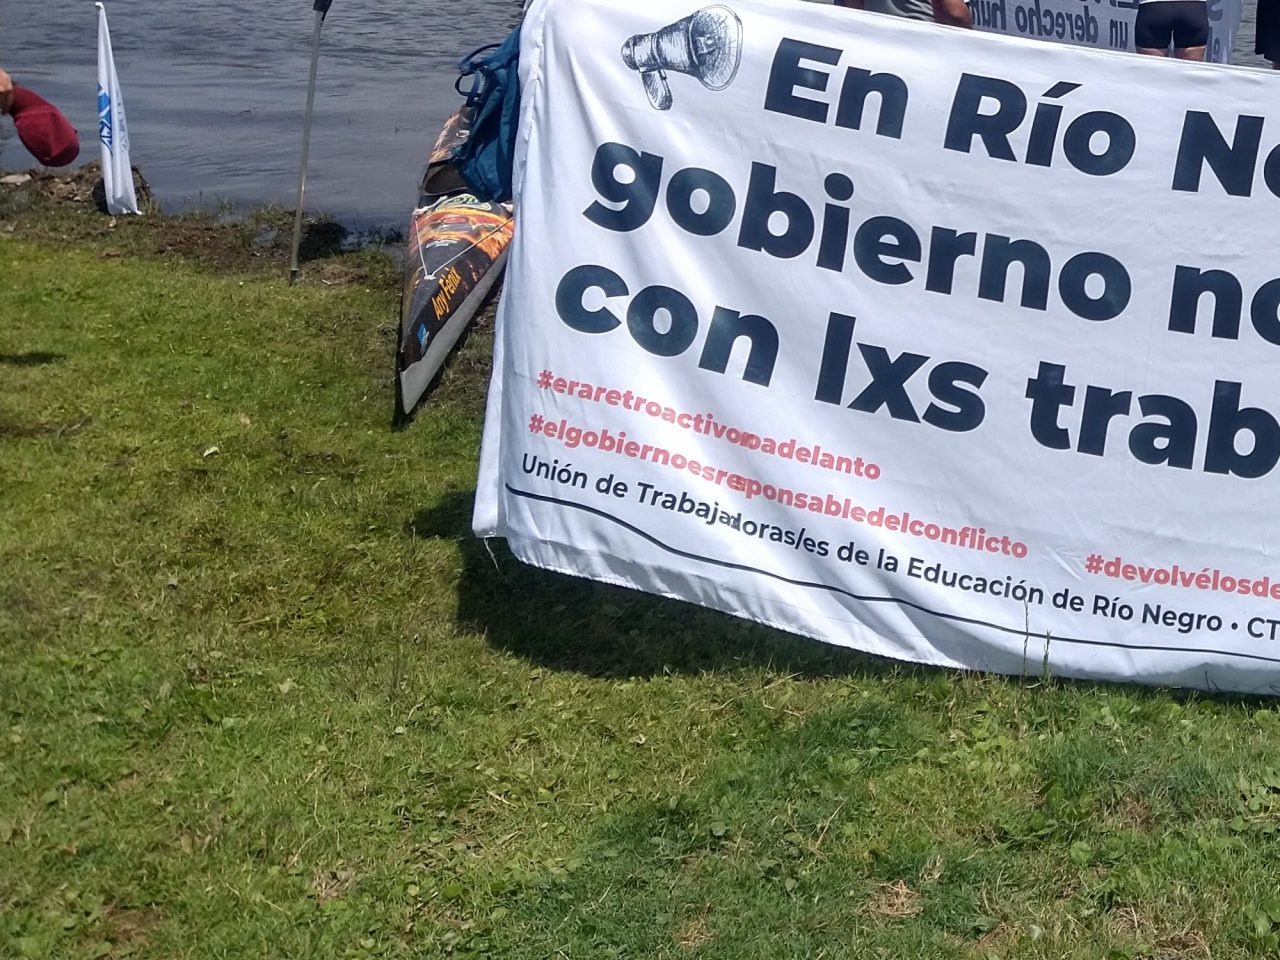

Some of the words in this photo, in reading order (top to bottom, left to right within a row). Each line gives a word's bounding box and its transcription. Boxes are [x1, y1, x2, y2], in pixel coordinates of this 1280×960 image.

[764, 37, 909, 140] En
[944, 72, 1136, 176] Río
[583, 141, 1132, 321] gobierno
[555, 264, 780, 388] con
[814, 311, 987, 433] lxs
[522, 453, 588, 489] Unión
[595, 473, 629, 498] de
[837, 541, 870, 565] de
[877, 548, 899, 573] la
[907, 557, 1044, 605] Educación
[1052, 588, 1085, 612] de
[1092, 594, 1134, 621] Río
[1142, 603, 1223, 634] Negro
